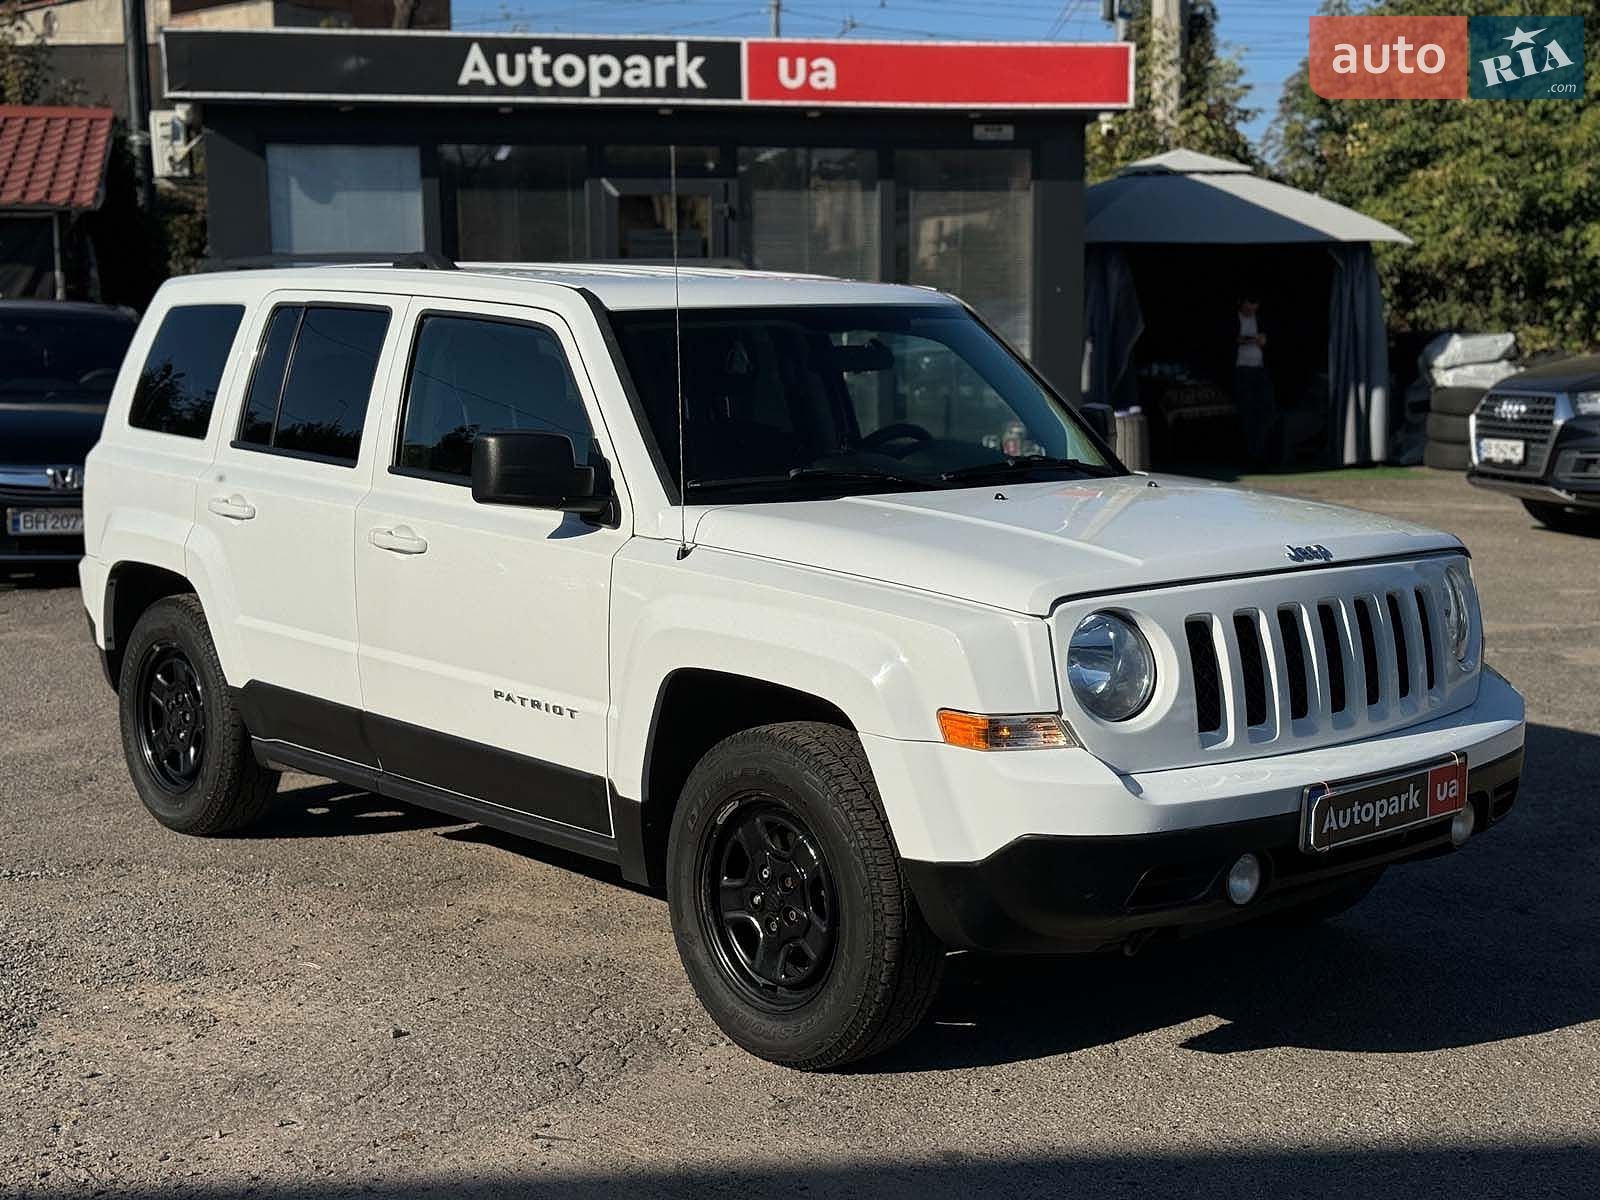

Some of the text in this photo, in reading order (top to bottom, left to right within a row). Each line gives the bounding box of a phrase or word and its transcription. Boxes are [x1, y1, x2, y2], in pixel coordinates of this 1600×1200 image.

[456, 41, 837, 98] Autopark ua
[51, 512, 84, 530] 207
[1285, 544, 1333, 562] Jeep
[493, 689, 579, 719] PATRIOT
[1321, 778, 1459, 834] Autopark ua
